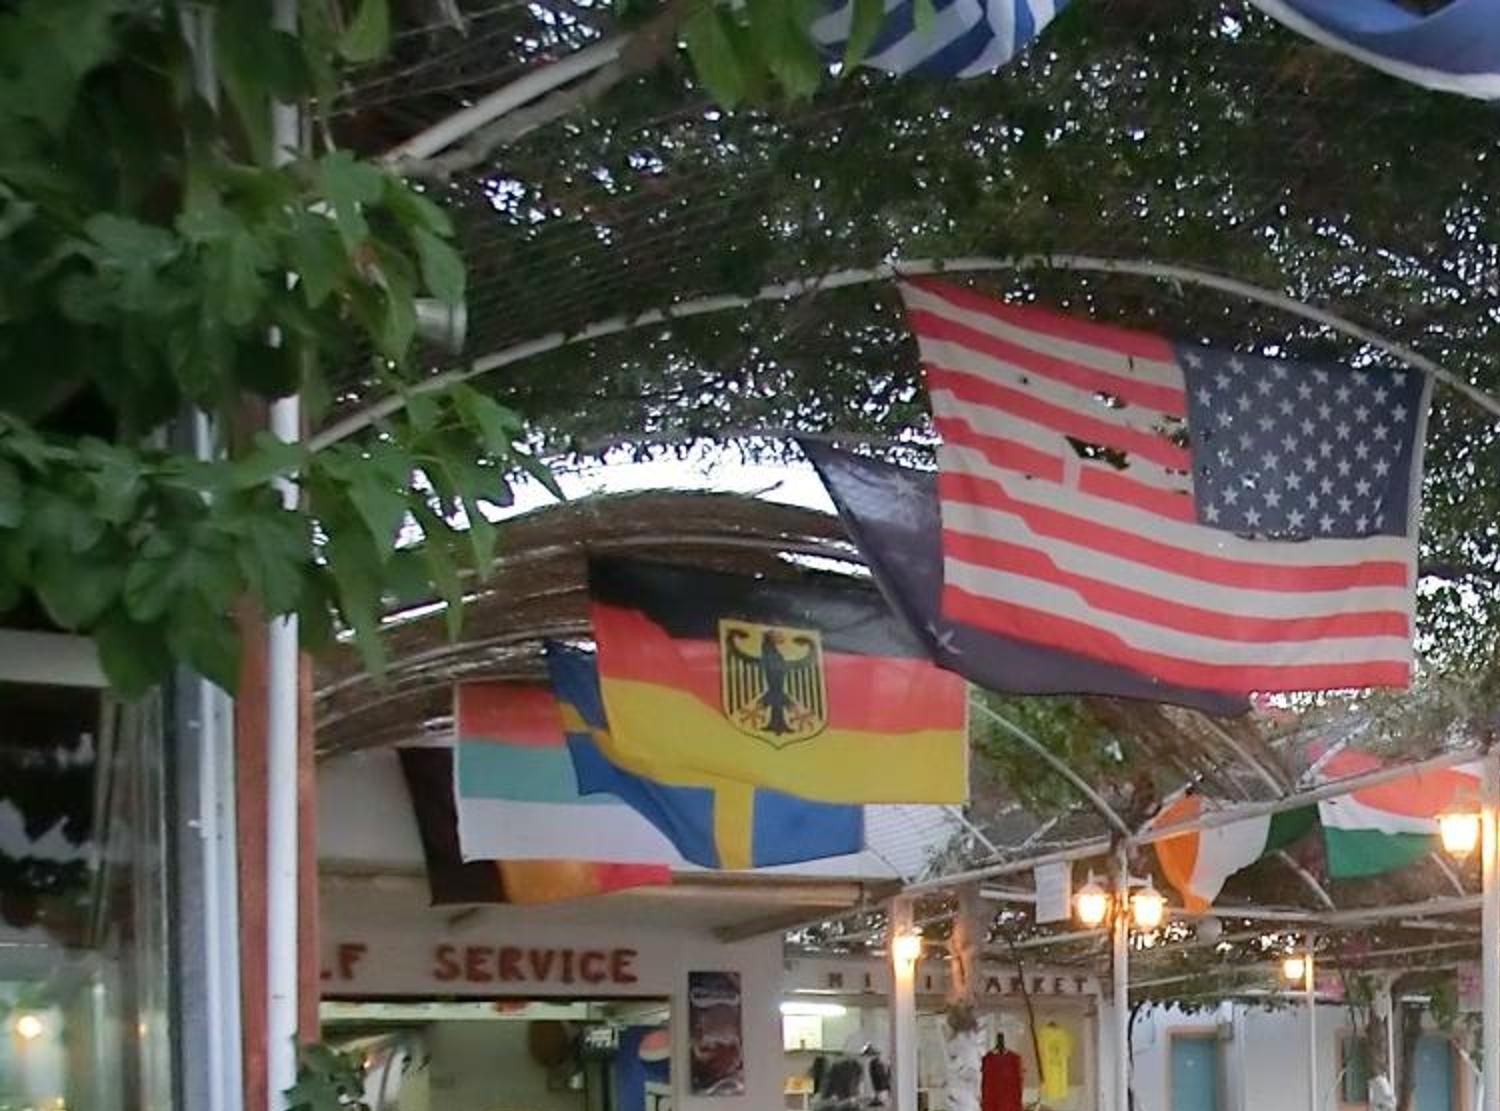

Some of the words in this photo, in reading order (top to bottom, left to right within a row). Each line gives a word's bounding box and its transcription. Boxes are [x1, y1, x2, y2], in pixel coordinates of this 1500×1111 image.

[432, 943, 638, 984] SERVICE
[827, 971, 933, 990] MII
[984, 975, 1089, 993] ARKET
